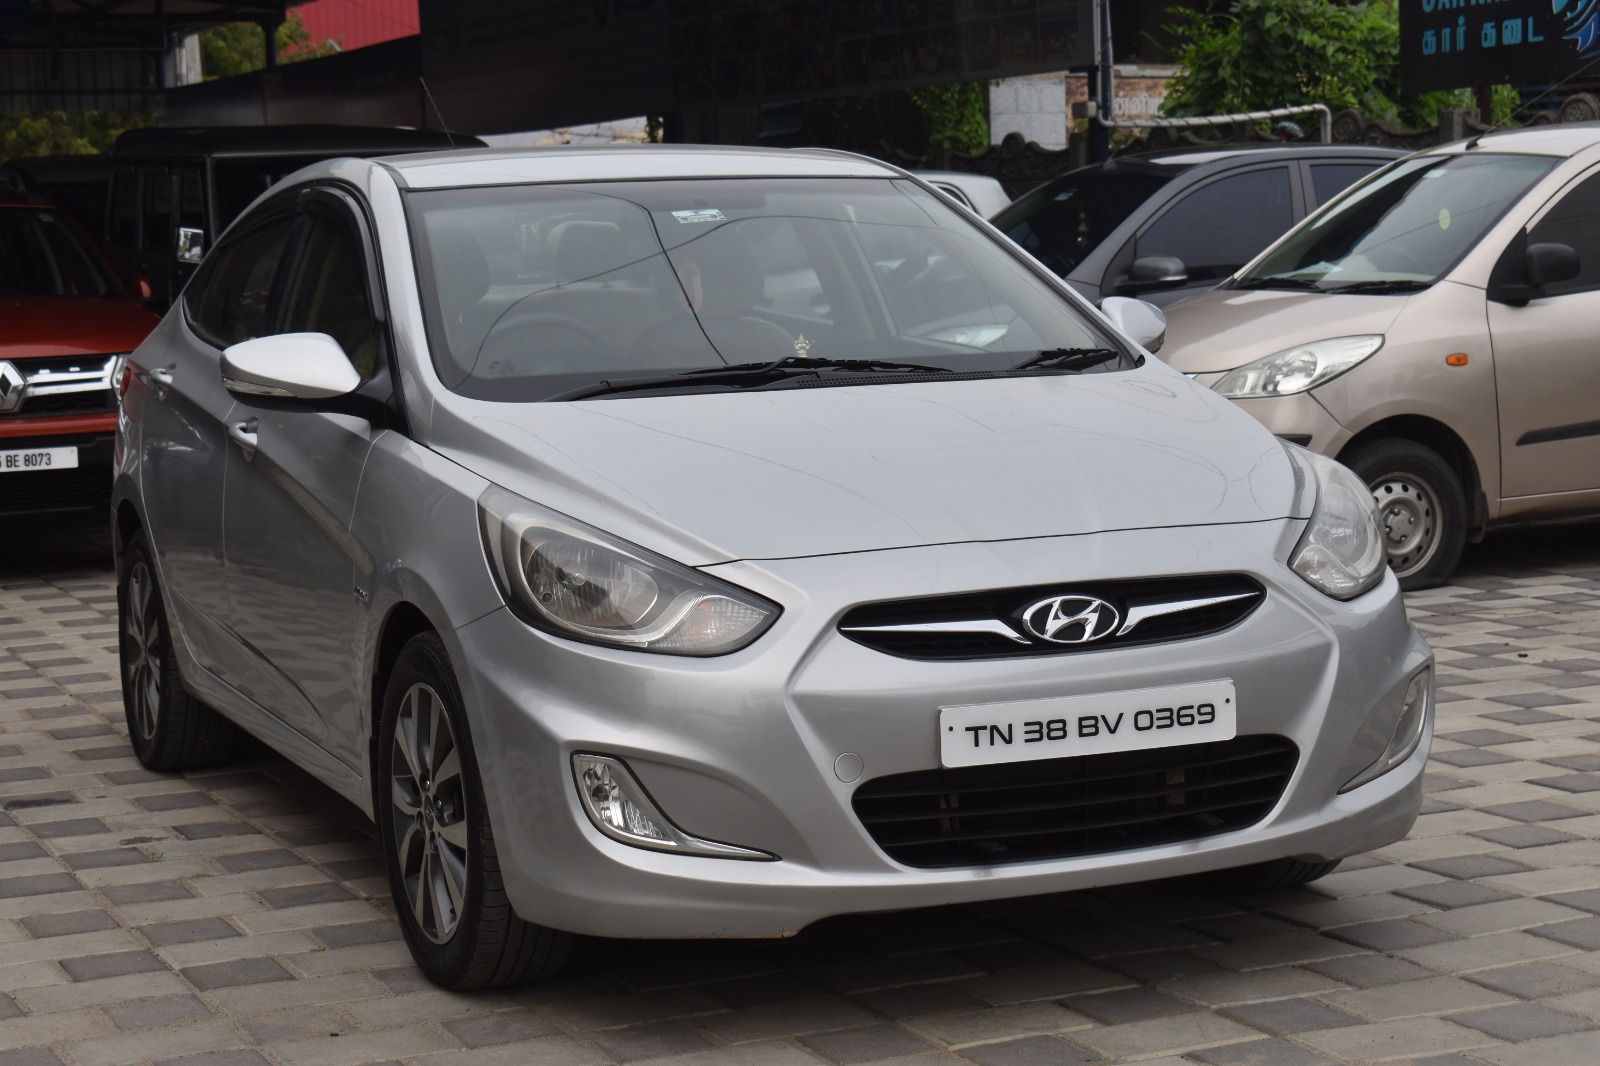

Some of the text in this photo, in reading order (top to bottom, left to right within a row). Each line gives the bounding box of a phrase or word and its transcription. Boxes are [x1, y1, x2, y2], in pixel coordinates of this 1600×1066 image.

[1422, 15, 1545, 55] கார் கடை
[5, 454, 20, 469] BE
[23, 452, 52, 467] 8073
[964, 702, 1216, 748] TN 38 BV 0369
